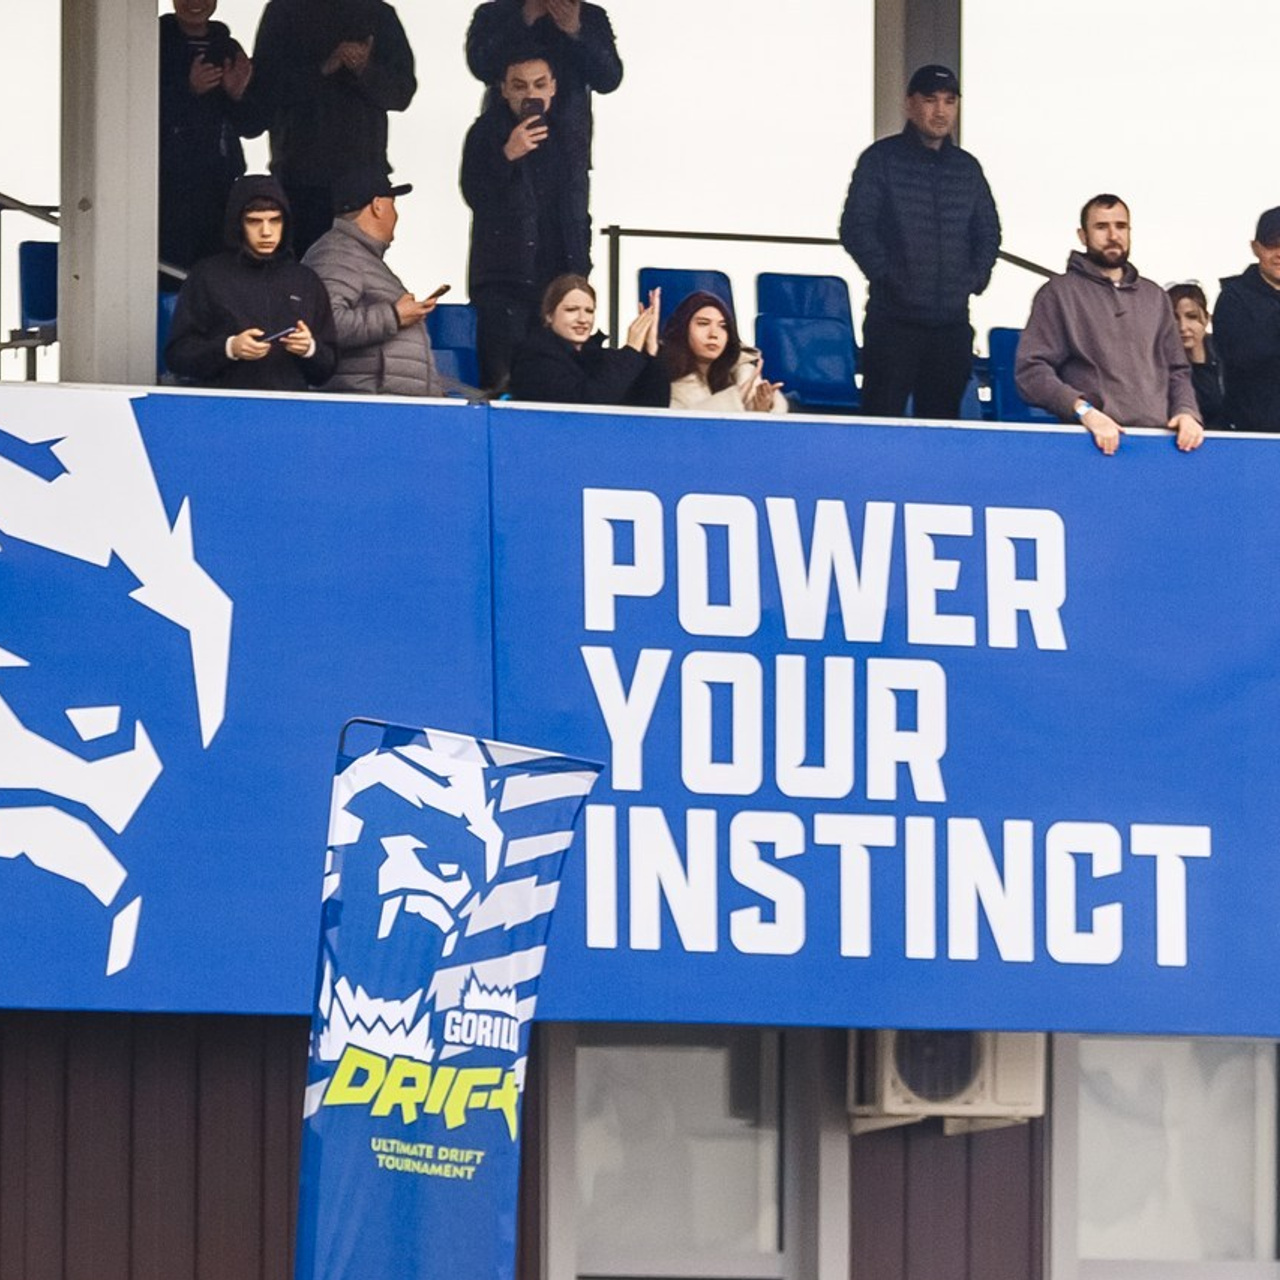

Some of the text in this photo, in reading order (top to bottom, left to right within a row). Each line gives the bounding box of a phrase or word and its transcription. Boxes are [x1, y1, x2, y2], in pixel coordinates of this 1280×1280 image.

[583, 487, 1067, 651] POWER
[580, 646, 947, 803] YOUR
[585, 805, 1211, 967] INSTINCT
[371, 1137, 485, 1165] ULTIMATE DRIFT
[376, 1154, 476, 1181] TOURNAMENT
